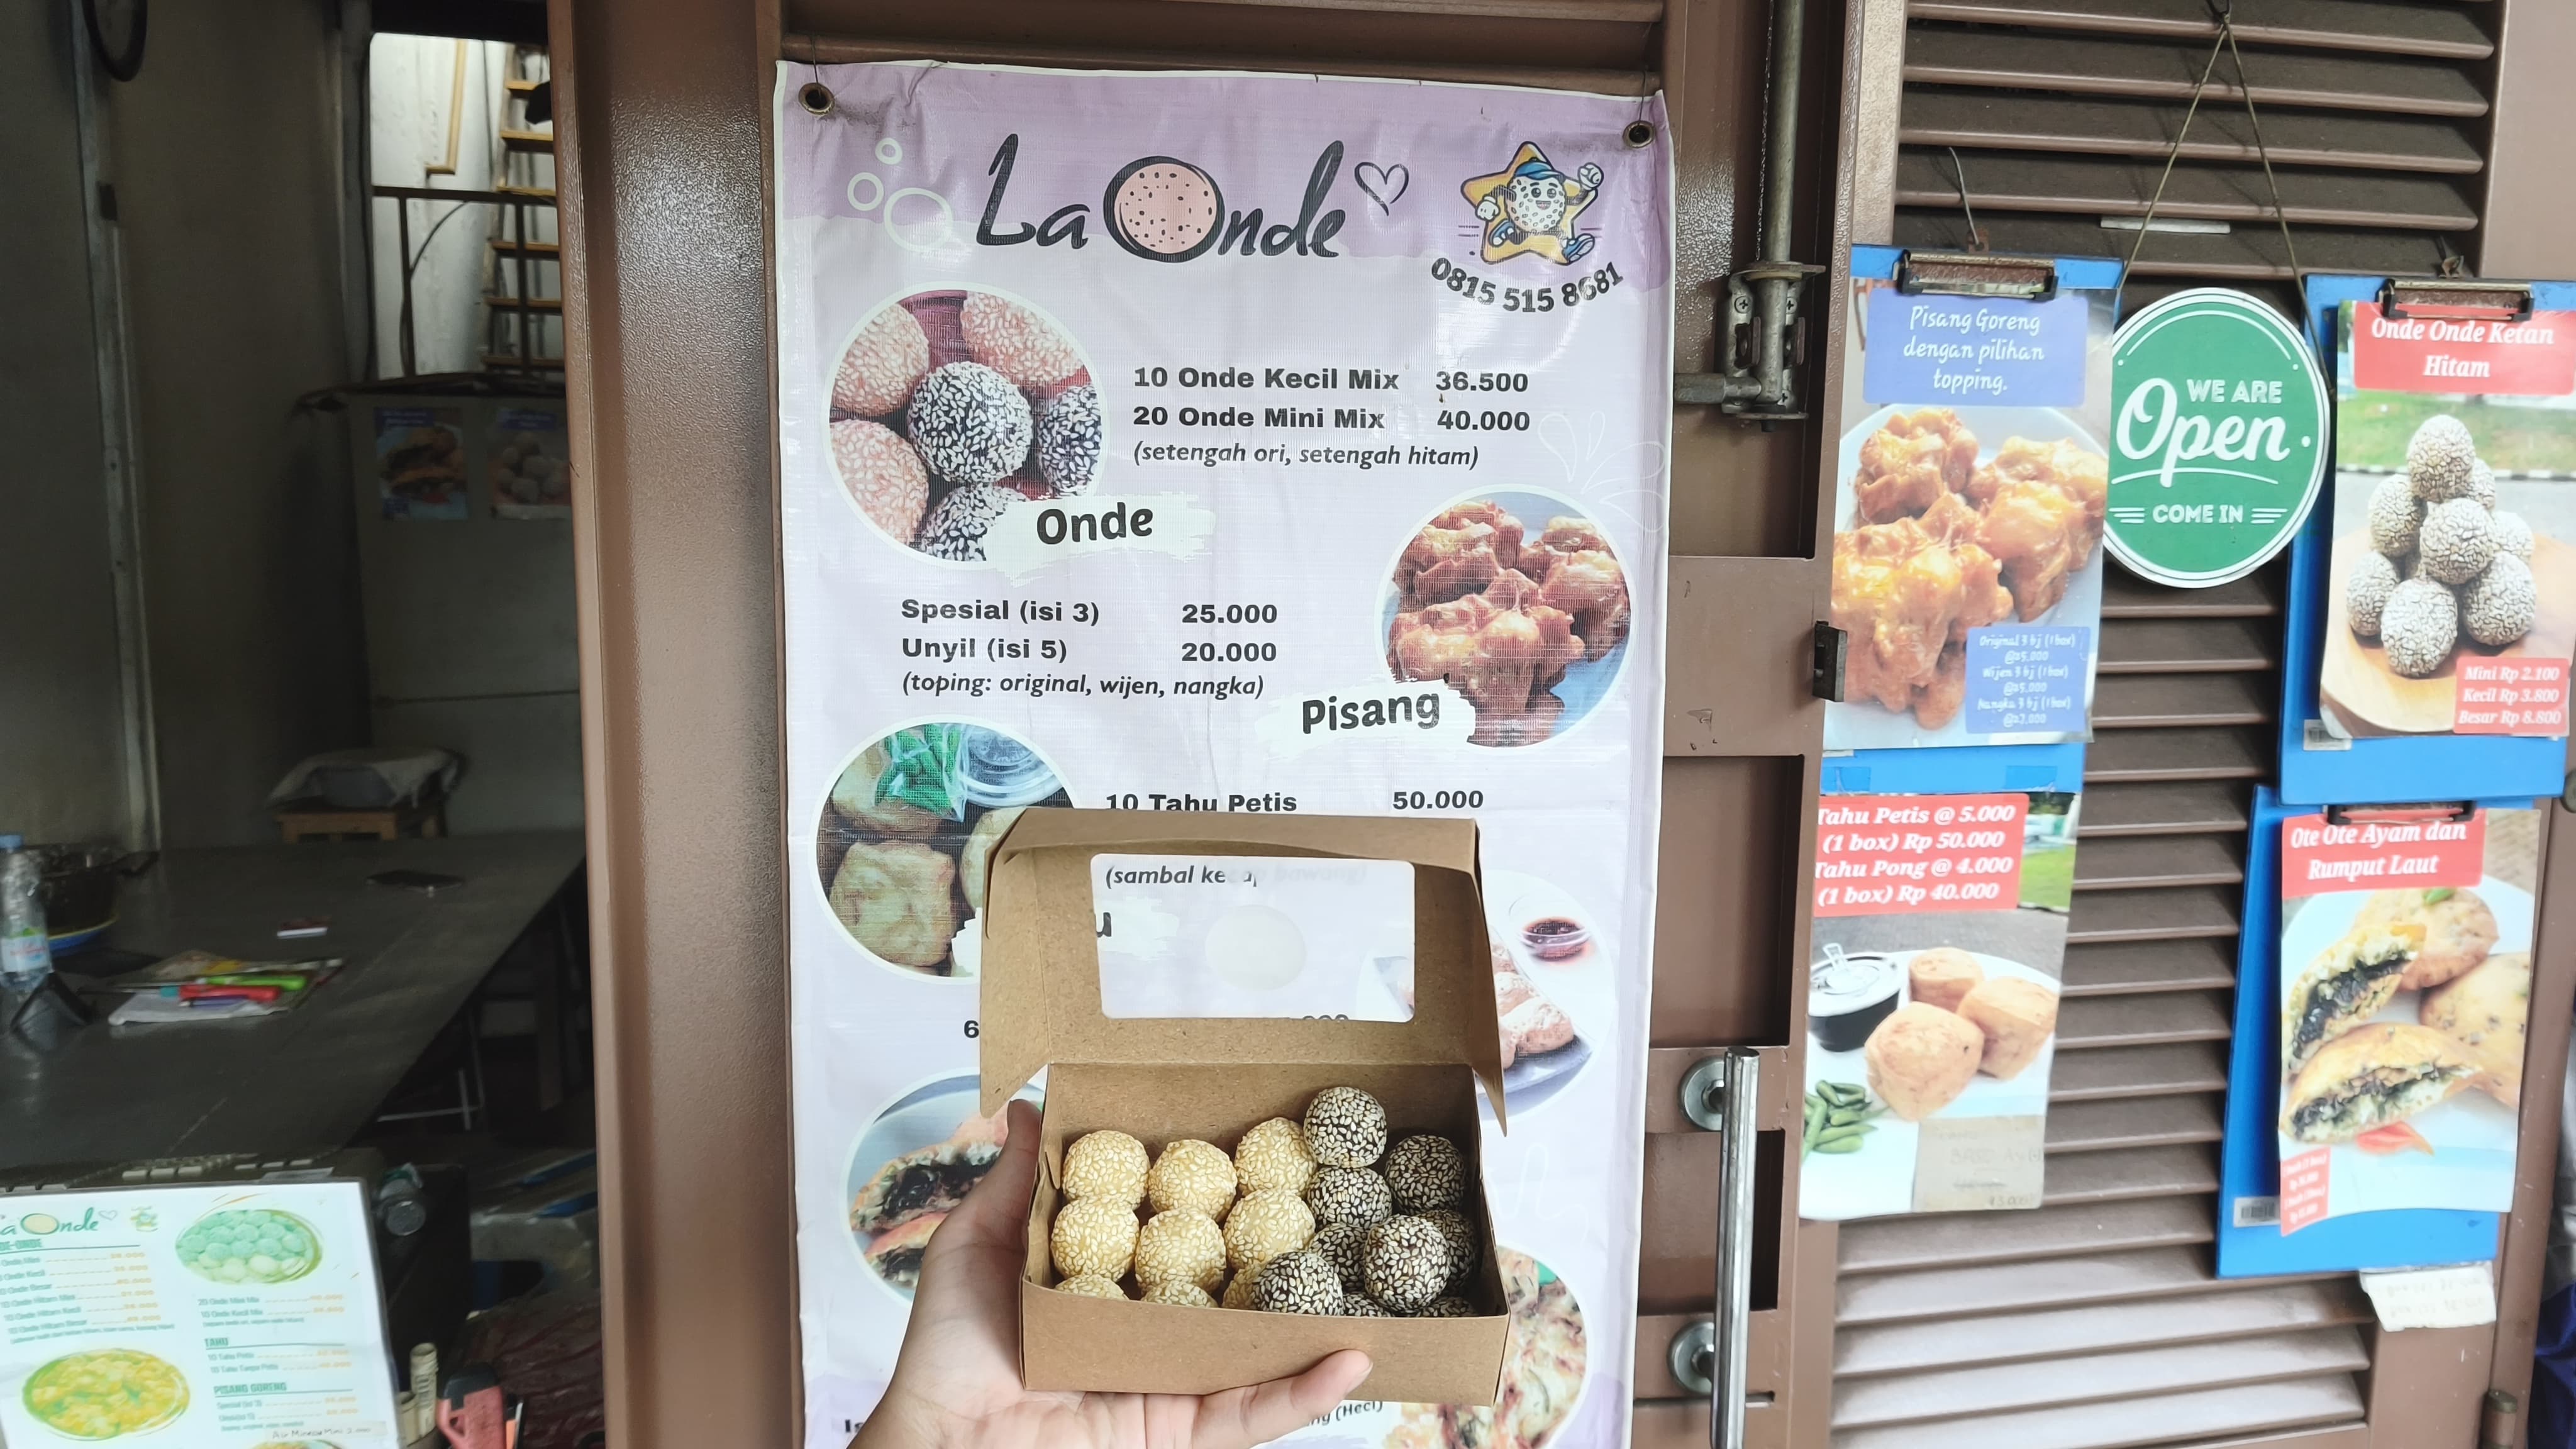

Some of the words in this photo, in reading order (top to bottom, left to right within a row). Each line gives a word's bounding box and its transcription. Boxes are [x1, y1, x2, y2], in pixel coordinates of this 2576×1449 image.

[977, 133, 1090, 250] La
[1103, 140, 1346, 263] Onde
[1431, 257, 1496, 305] 0815
[1503, 287, 1555, 313] 515
[1561, 262, 1624, 307] 8681
[1909, 306, 1970, 334] Pisang
[1975, 308, 2041, 336] Goreng
[2371, 318, 2423, 341] Onde
[2429, 320, 2482, 343] Onde
[2487, 323, 2554, 345] Ketan
[1903, 336, 1974, 364] dengan
[1979, 338, 2045, 365] pilihan
[2423, 354, 2490, 378] Hitam
[1134, 367, 1167, 388] 10
[1179, 368, 1254, 388] Onde
[1264, 368, 1337, 389] Kecil
[1349, 369, 1399, 390] Mix
[1436, 371, 1528, 392] 36.500
[1933, 369, 2008, 396] topping.
[2186, 379, 2225, 403] WE
[2231, 380, 2282, 404] ARE
[1133, 406, 1168, 426] 20
[1179, 407, 1254, 427] Onde
[1264, 408, 1324, 428] Mini
[1335, 408, 1385, 429] Mix
[1436, 410, 1530, 431] 40.000
[2116, 377, 2290, 489] Open
[1134, 440, 1246, 467] (setengah
[1254, 444, 1291, 466] ori,
[1299, 445, 1401, 470] setengah
[1407, 445, 1479, 470] hitam)
[1037, 502, 1153, 545] Onde
[2152, 504, 2213, 524] COME
[2219, 505, 2244, 524] IN
[901, 599, 1009, 623] Spesial
[1019, 600, 1062, 624] (isi
[1072, 602, 1099, 626] 3)
[1182, 604, 1278, 624] 25.000
[902, 638, 975, 662] Unyil
[987, 638, 1030, 662] (isi
[1041, 639, 1067, 663] 5)
[1182, 642, 1277, 662] 20.000
[902, 671, 992, 697] (toping:
[999, 675, 1091, 697] original,
[1100, 676, 1165, 699] wijen,
[1174, 675, 1263, 701] nangka)
[2464, 665, 2497, 680] Mini
[2500, 666, 2519, 685] Rp
[2521, 667, 2560, 681] 2.100
[2462, 687, 2497, 702] Kecil
[2499, 689, 2519, 706] Rp
[2521, 688, 2560, 703] 3.800
[1302, 693, 1440, 735] Pisang
[2458, 709, 2498, 724] Besar
[2500, 709, 2520, 728] Rp
[2523, 710, 2562, 724] 8.800
[1106, 793, 1139, 811] 10
[1148, 794, 1217, 812] Tahu
[1228, 792, 1297, 813] Petis
[1392, 790, 1484, 810] 50.000
[1818, 806, 1869, 825] Tahu
[1873, 805, 1931, 825] Petis
[1934, 809, 1955, 826] @
[1958, 804, 2016, 823] 5.000
[1822, 833, 1843, 854] (1
[1848, 832, 1899, 852] box)
[1902, 833, 1933, 853] Rp
[1936, 831, 2005, 849] 50.000
[2290, 828, 2319, 848] Ote
[2323, 824, 2358, 845] Ote
[2360, 823, 2421, 849] Ayam
[2426, 820, 2467, 841] dan
[1106, 865, 1194, 889] (sambal
[1814, 860, 1867, 879] Tahu
[1871, 858, 1929, 880] Pong
[1931, 860, 1952, 877] @
[1957, 856, 2012, 875] 4.000
[2307, 857, 2385, 882] Rumput
[2389, 855, 2439, 875] Laut
[1817, 887, 1839, 906] (1
[1844, 884, 1893, 904] box)
[1896, 885, 1926, 906] Rp
[1929, 882, 2000, 901] 40.000
[963, 1019, 980, 1039] 6
[0, 1225, 17, 1236] a
